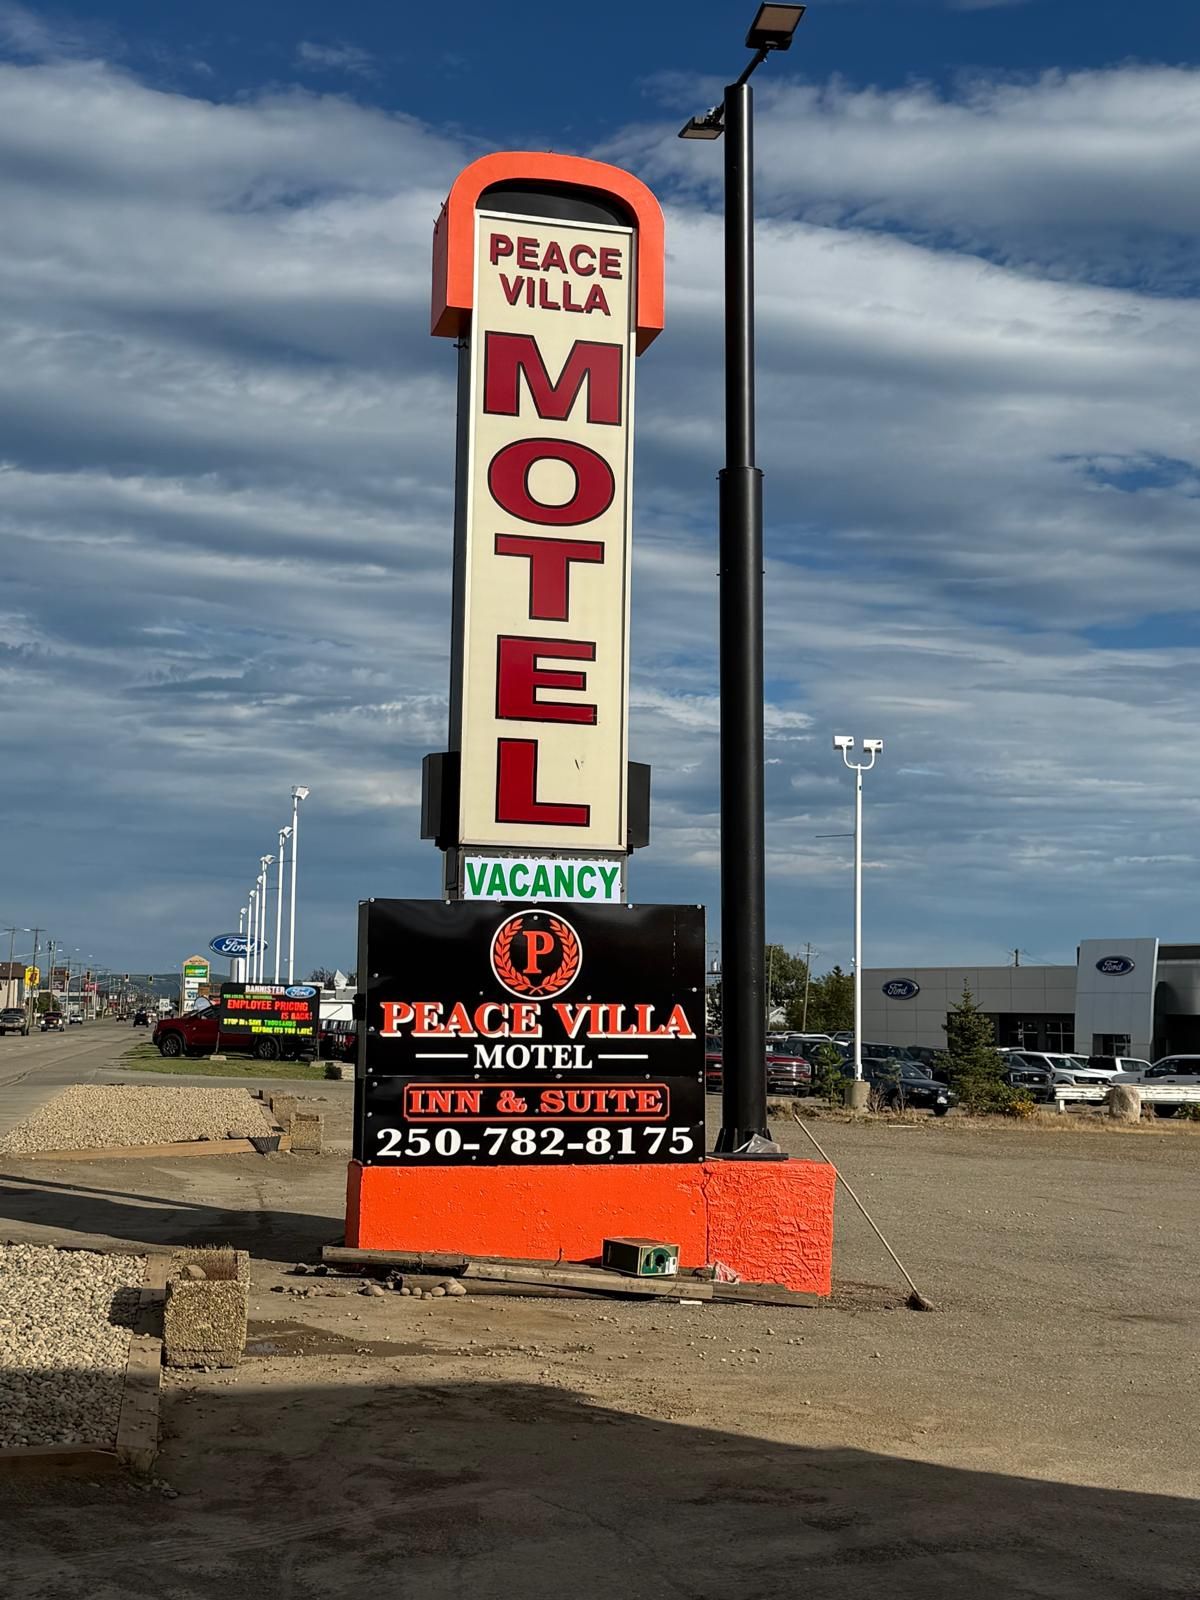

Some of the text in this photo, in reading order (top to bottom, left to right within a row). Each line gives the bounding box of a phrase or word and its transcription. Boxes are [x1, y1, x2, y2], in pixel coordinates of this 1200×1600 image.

[489, 232, 624, 279] PEACE
[498, 273, 612, 316] VILLA
[483, 330, 624, 828] MOTEL
[466, 862, 619, 899] VACANCY
[522, 930, 555, 975] P
[227, 1000, 309, 1011] EMPLOYEE PRICING
[379, 1001, 696, 1040] PEACE VILLA
[474, 1044, 593, 1070] MOTEL
[409, 1090, 663, 1113] INN & SUITE
[376, 1126, 694, 1157] 250-782-8175
